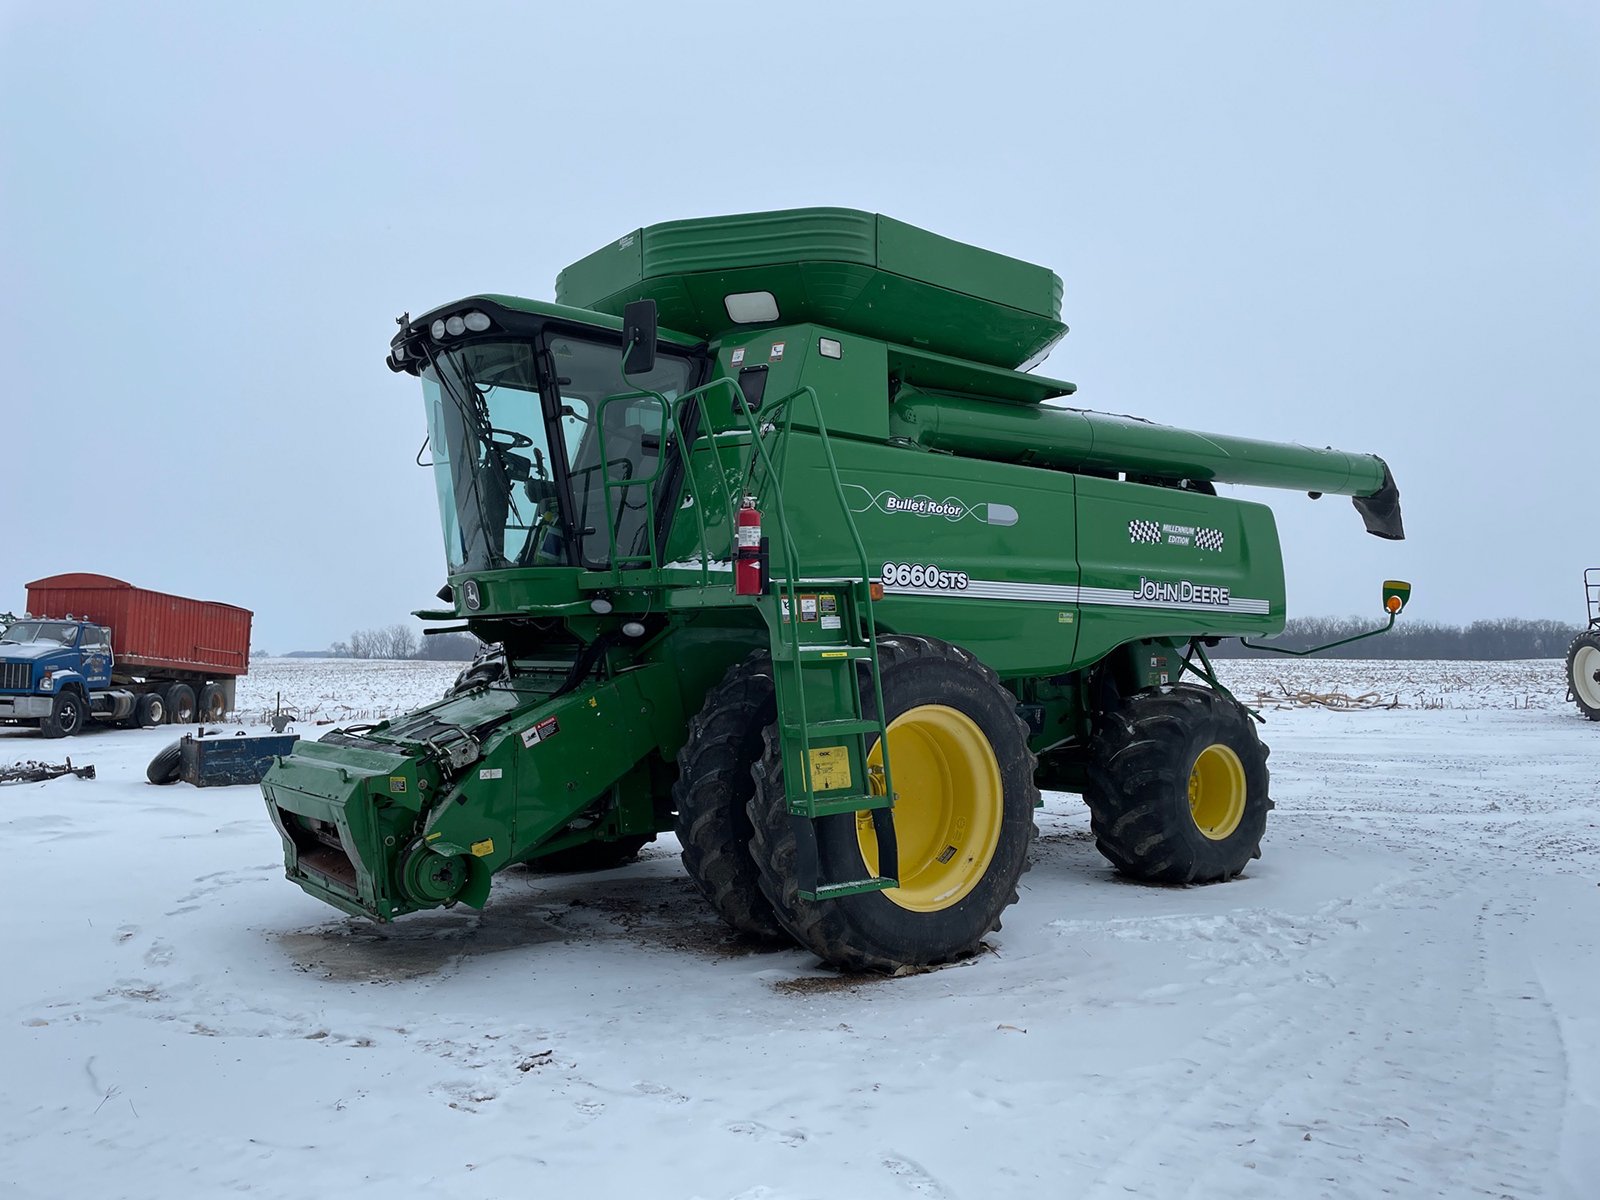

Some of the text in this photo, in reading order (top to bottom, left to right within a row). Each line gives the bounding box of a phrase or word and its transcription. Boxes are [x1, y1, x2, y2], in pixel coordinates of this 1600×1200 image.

[887, 497, 961, 515] Bullet Rotor
[1163, 524, 1195, 535] MILLENNIUM
[1168, 535, 1190, 545] EDITION
[882, 563, 968, 589] 9660STS
[1134, 577, 1229, 605] JOHN DEERE
